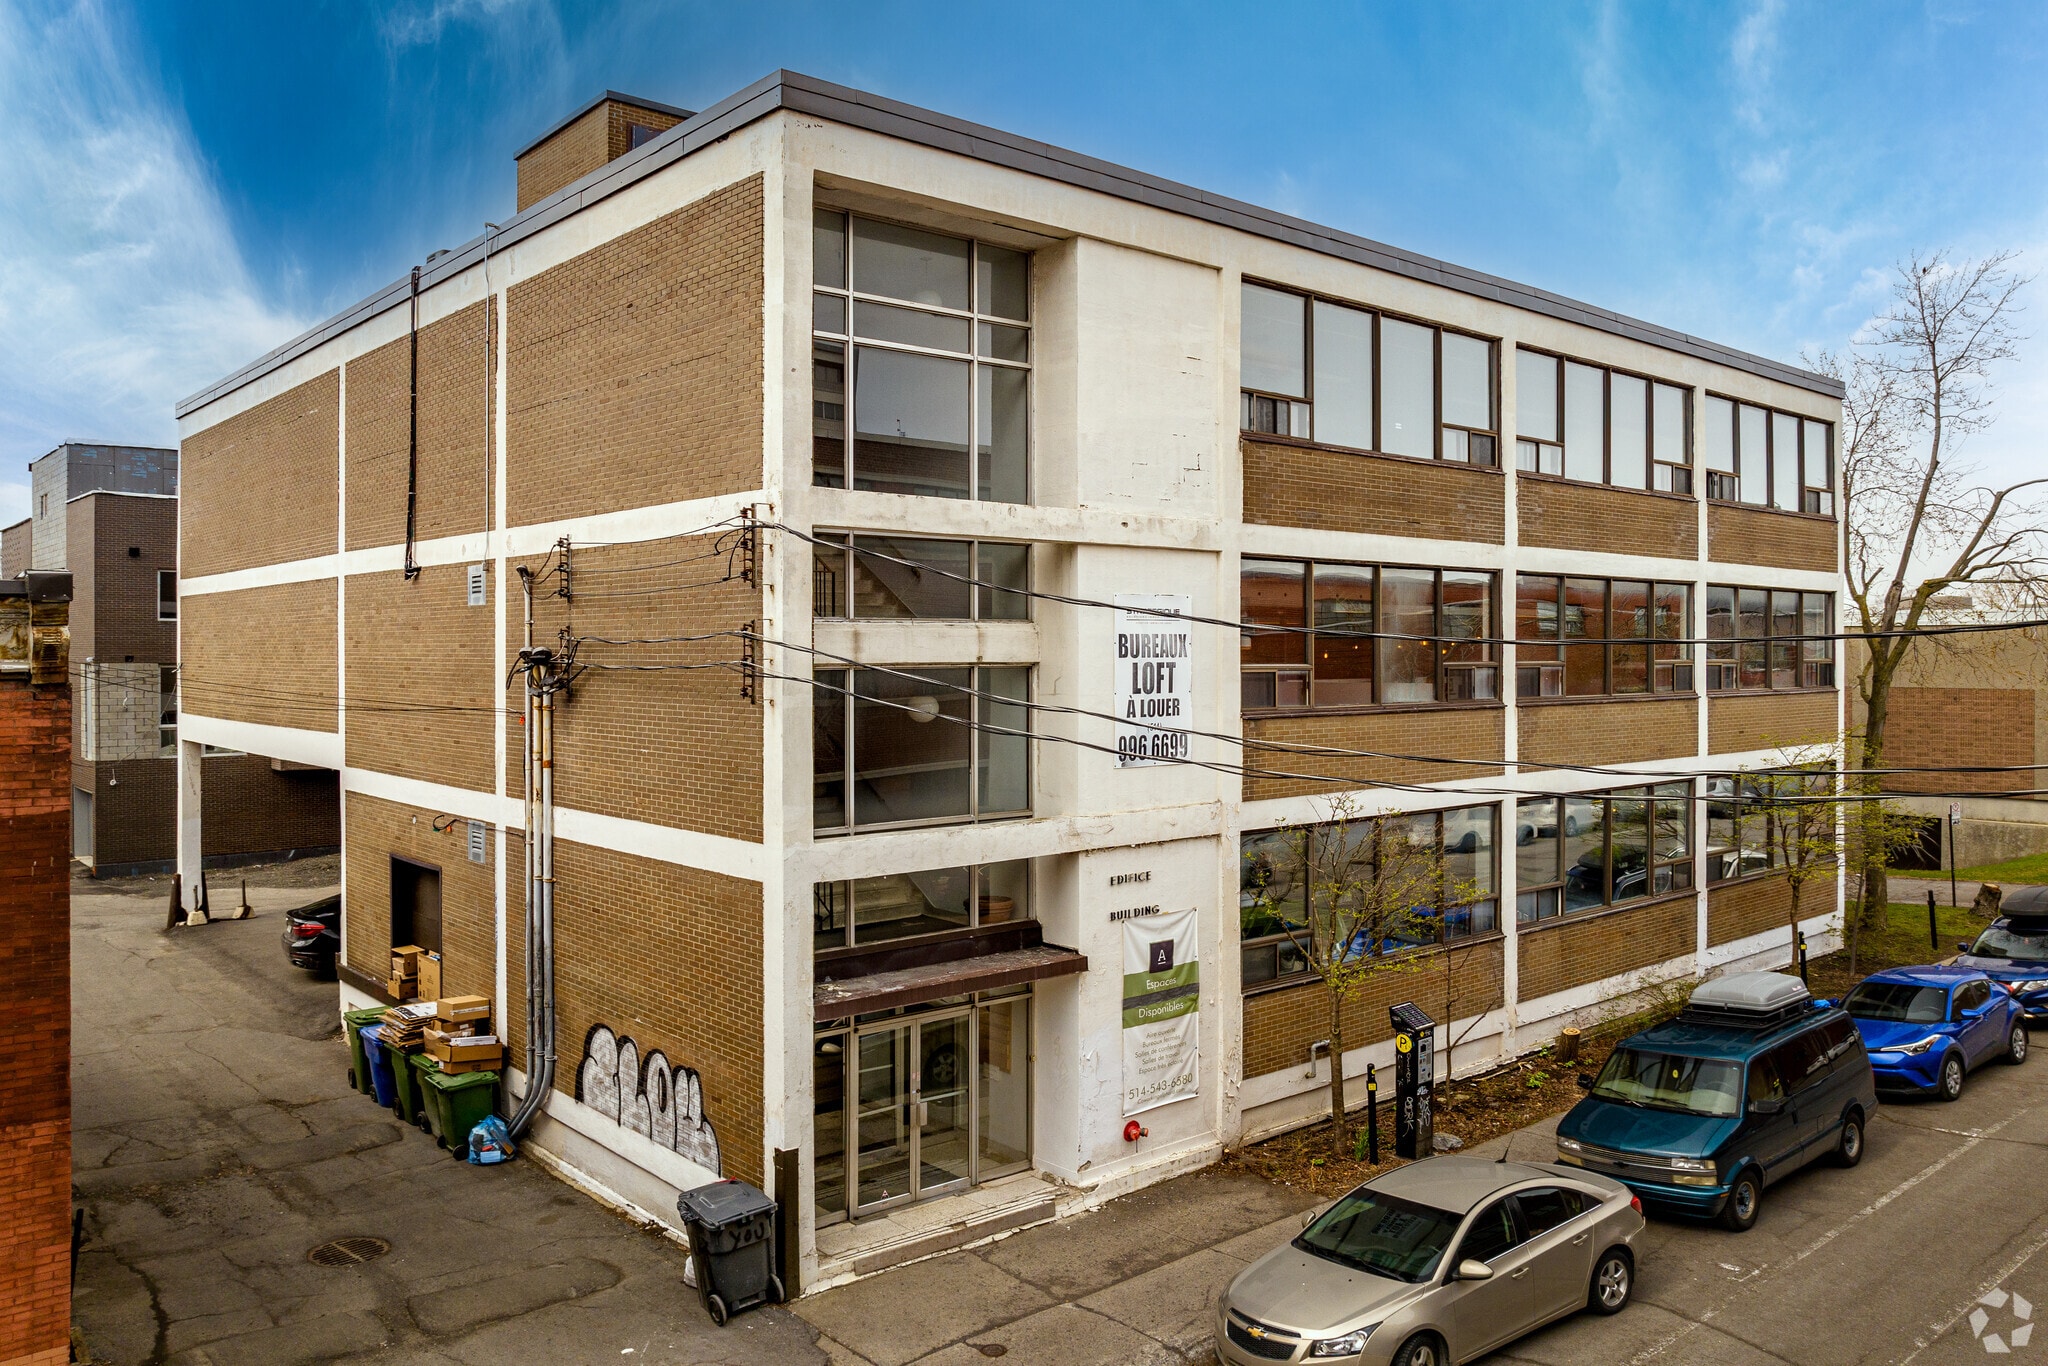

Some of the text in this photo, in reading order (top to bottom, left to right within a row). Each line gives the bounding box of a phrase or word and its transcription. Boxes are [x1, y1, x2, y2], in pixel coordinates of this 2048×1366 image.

[1118, 633, 1188, 659] BUREAUX
[1132, 661, 1177, 695] LOFT
[1126, 694, 1180, 719] À LOUER
[1118, 732, 1188, 762] 996 6699
[1109, 870, 1152, 887] EDIFICE
[1109, 904, 1160, 922] BUILDING
[1157, 949, 1167, 962] A
[1146, 977, 1177, 990] Espaces
[1138, 1002, 1184, 1018] Disponibles
[1128, 1072, 1193, 1100] 514-543-6580
